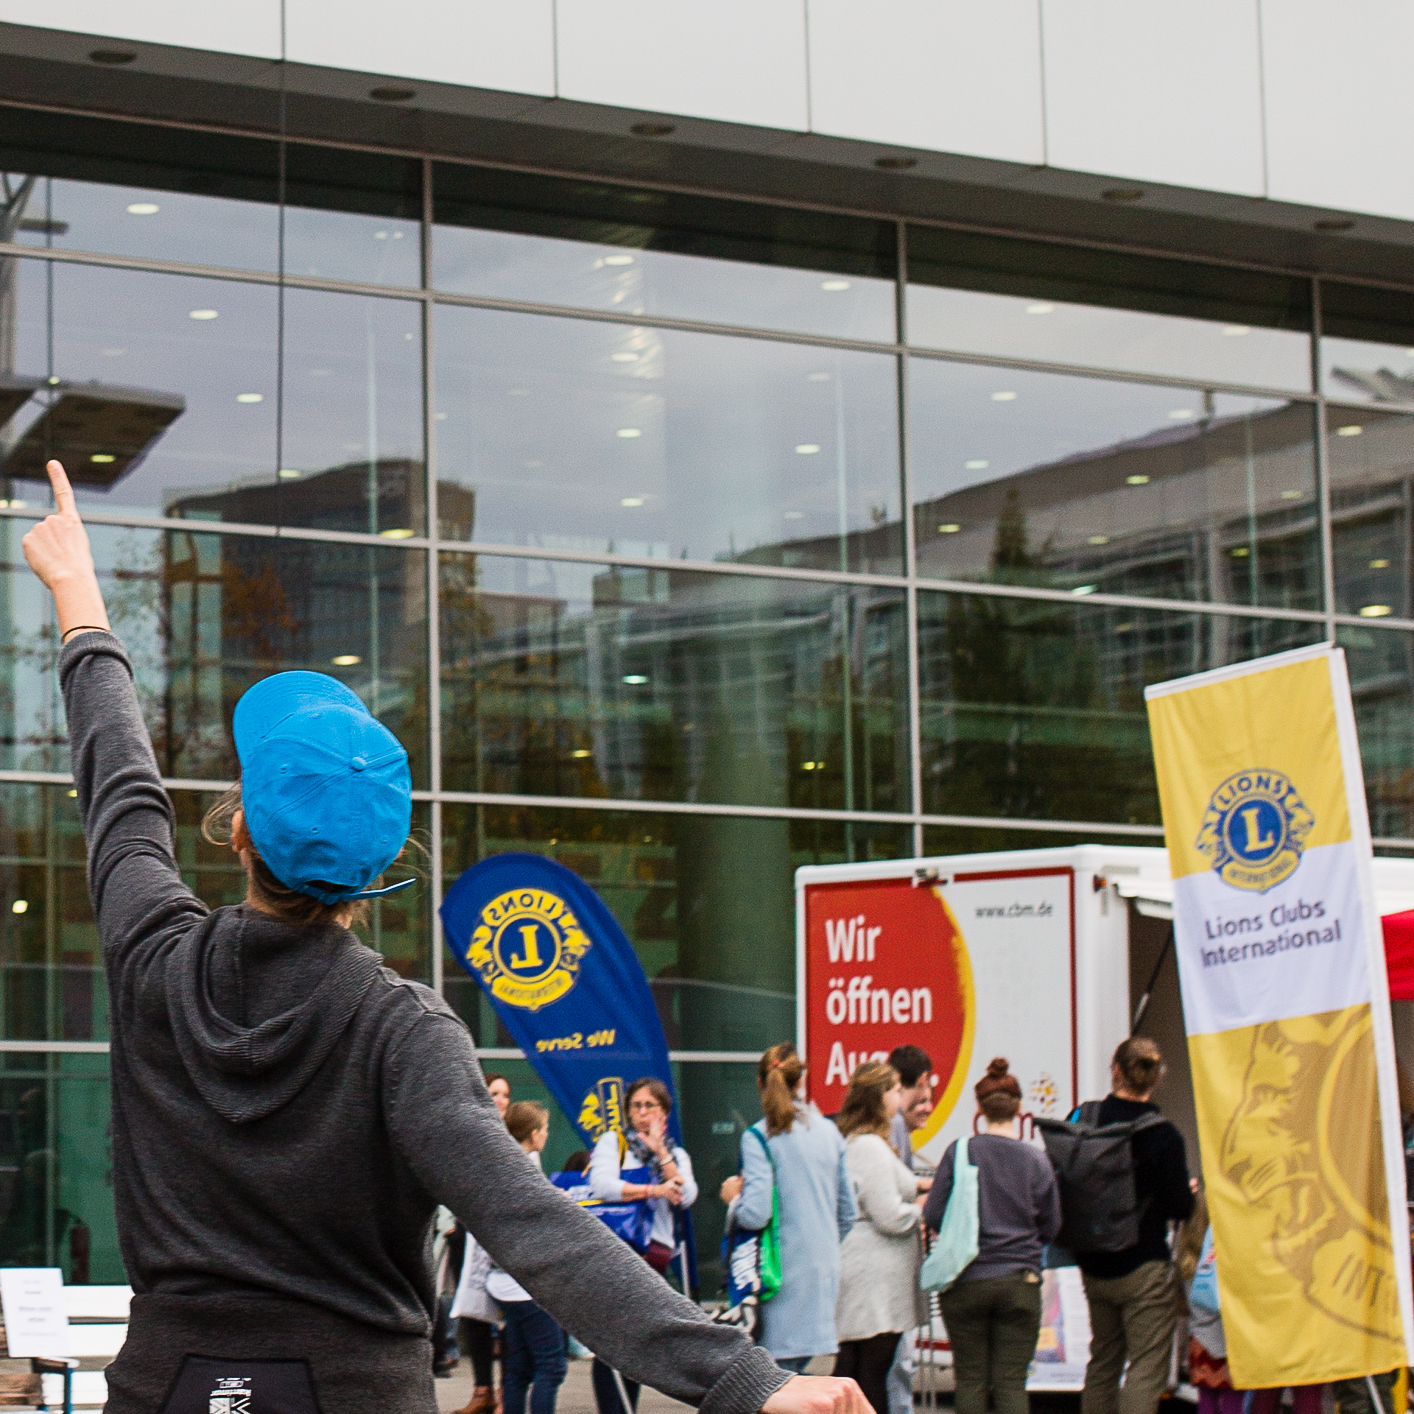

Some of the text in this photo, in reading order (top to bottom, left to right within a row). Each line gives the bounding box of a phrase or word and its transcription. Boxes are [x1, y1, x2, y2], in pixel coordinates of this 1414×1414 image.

[1217, 774, 1284, 805] LIONS
[1240, 806, 1276, 853] L
[975, 901, 1053, 919] www.cbm.de
[1205, 898, 1327, 940] Lions Clubs
[824, 914, 883, 963] Wir
[1200, 918, 1343, 969] International
[826, 975, 933, 1025] öffnen
